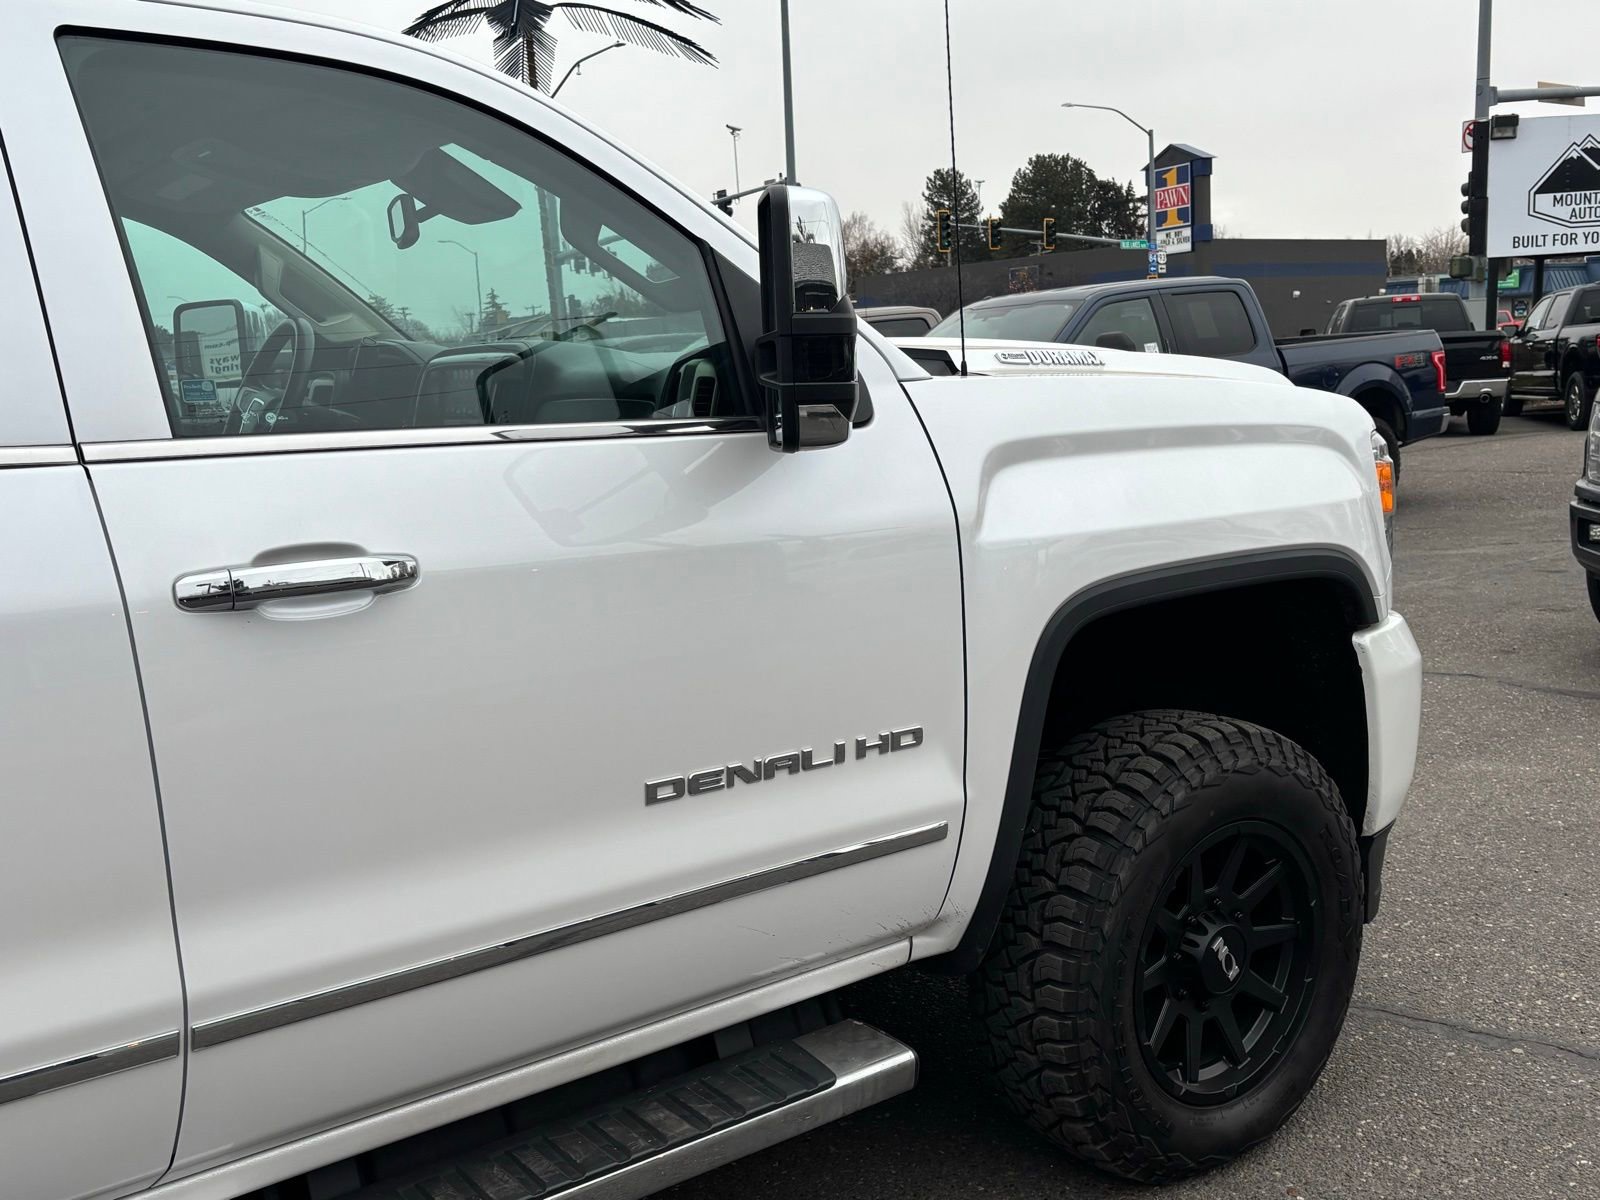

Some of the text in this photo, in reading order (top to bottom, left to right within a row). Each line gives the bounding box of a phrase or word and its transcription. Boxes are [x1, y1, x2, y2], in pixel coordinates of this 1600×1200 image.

[1156, 186, 1189, 209] PAWN
[1512, 234, 1549, 249] BUILT
[1552, 232, 1578, 247] FOR
[645, 725, 924, 807] DENALI HD
